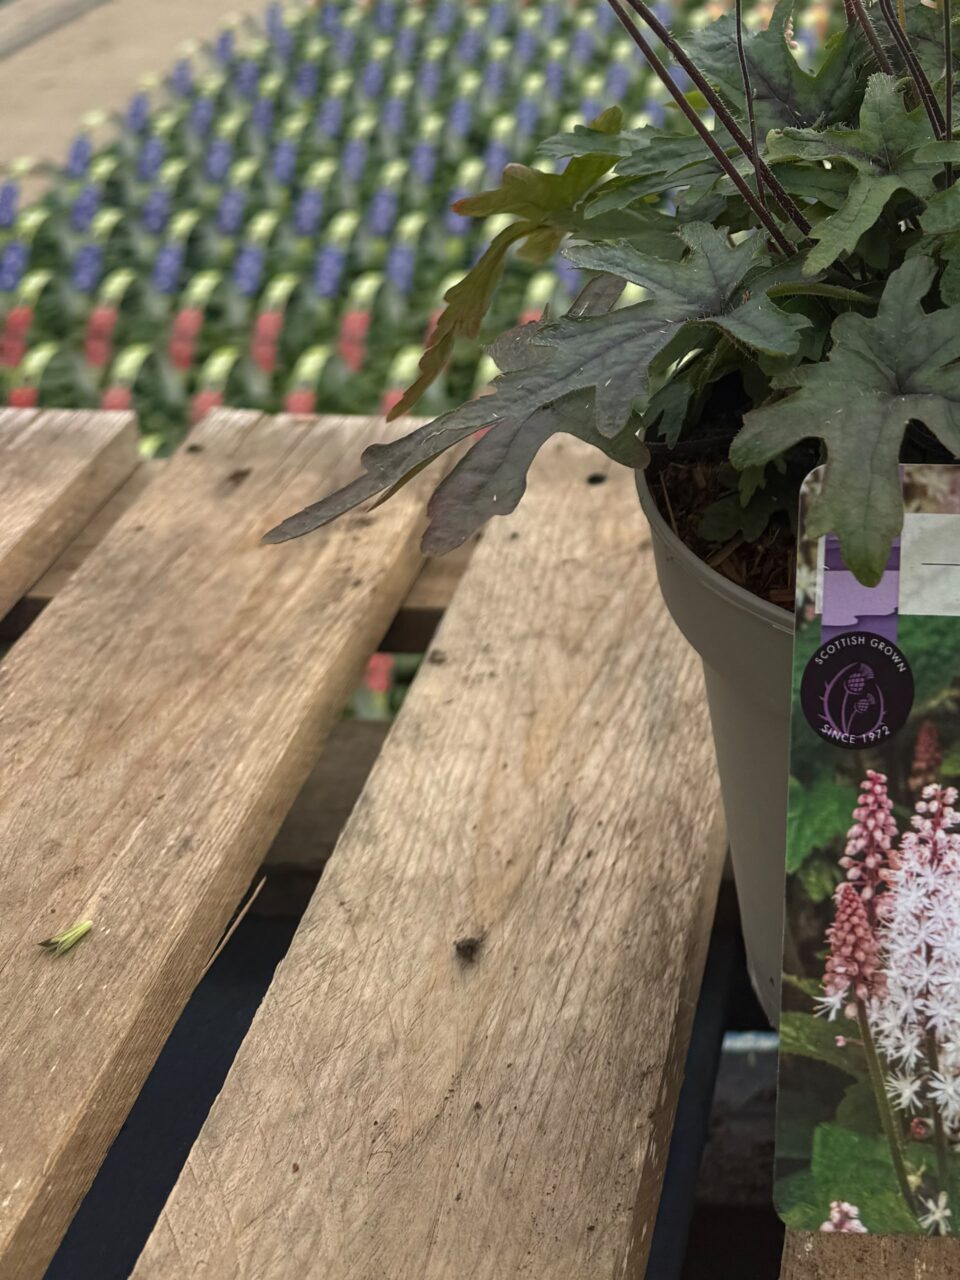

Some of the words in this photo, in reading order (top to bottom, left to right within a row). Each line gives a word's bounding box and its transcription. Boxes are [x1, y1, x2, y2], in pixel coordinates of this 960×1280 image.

[815, 636, 866, 665] SCOTTISH
[870, 638, 907, 673] GROWN
[821, 724, 856, 744] SINCE
[862, 725, 891, 743] 1972
